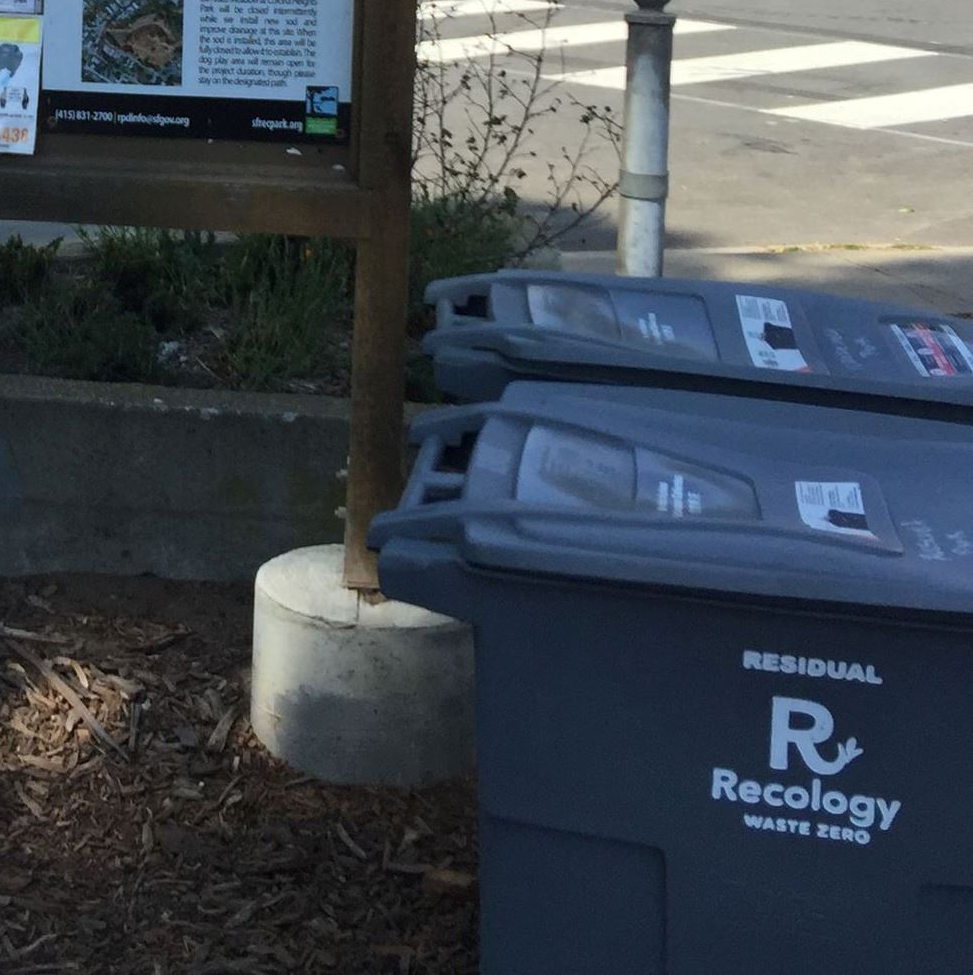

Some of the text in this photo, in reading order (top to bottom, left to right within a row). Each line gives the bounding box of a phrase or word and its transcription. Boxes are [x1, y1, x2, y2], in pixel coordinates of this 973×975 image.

[76, 110, 113, 122] 831-2700
[252, 119, 303, 133] sfrecpark.org
[742, 650, 884, 685] RESIDUAL
[711, 767, 902, 831] Recology
[743, 813, 871, 845] WASTE ZERO
